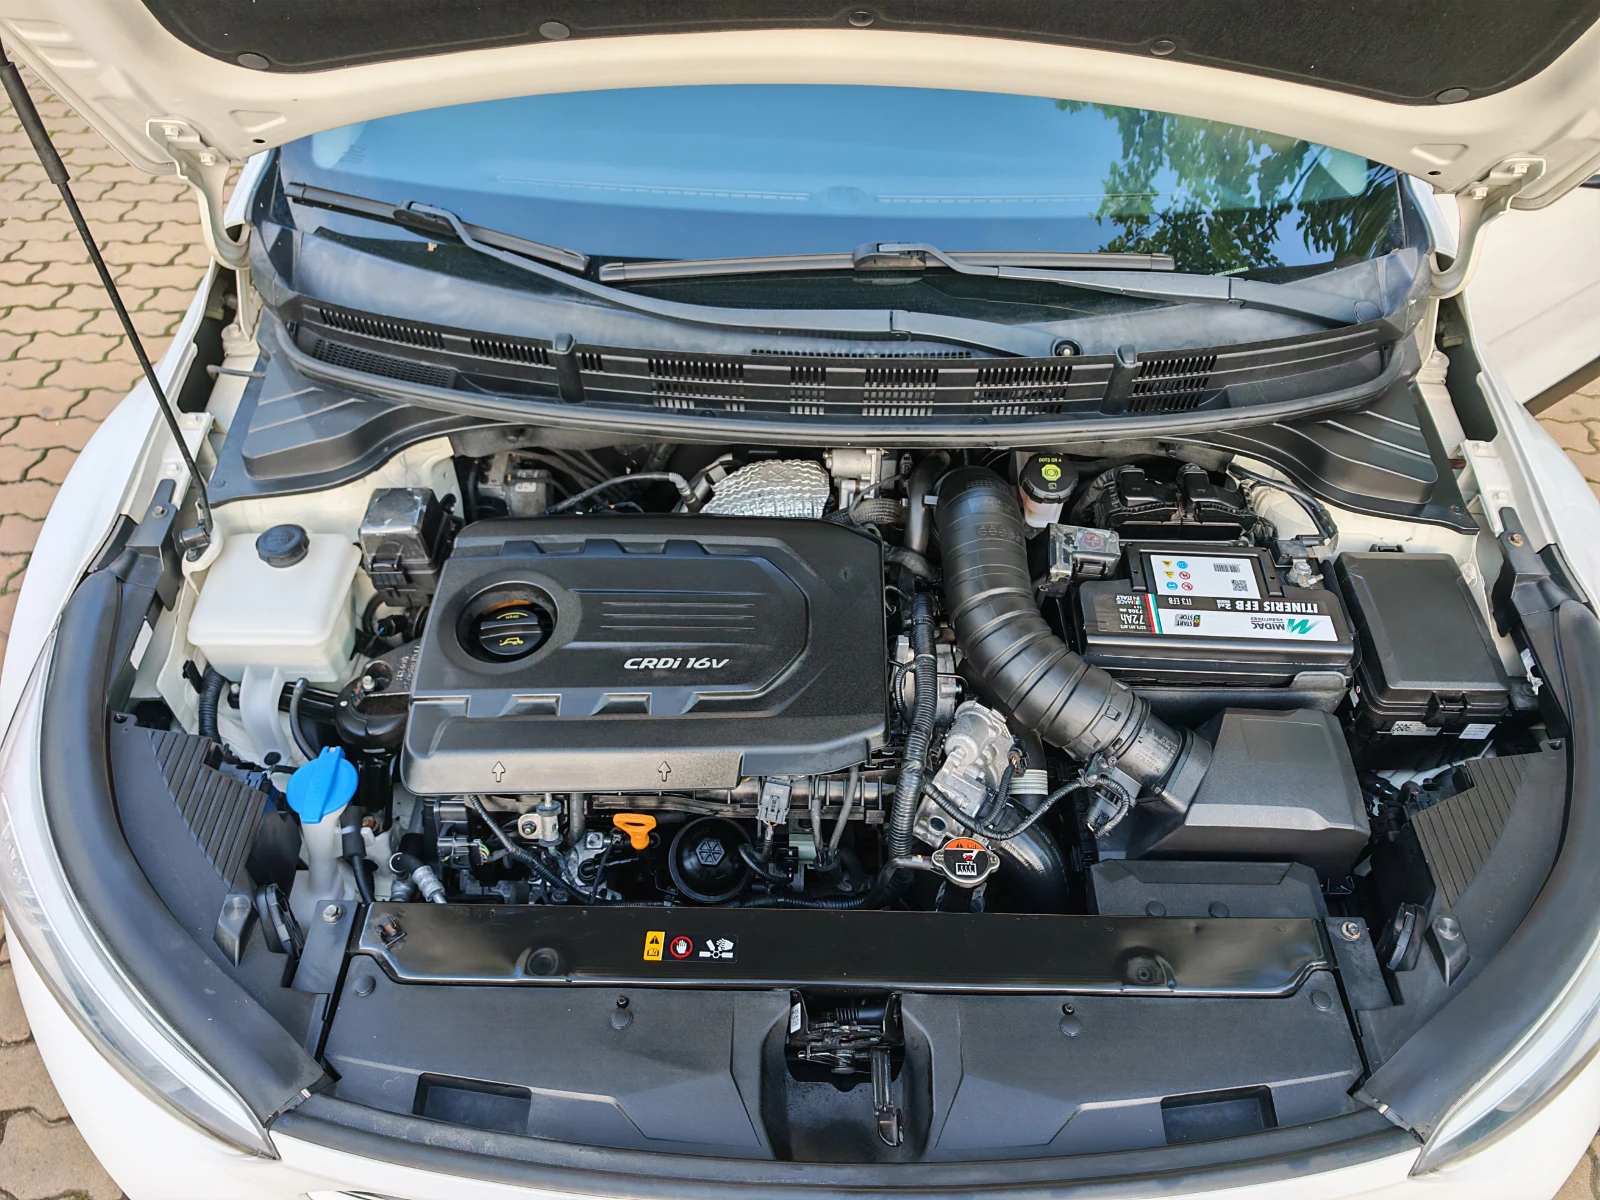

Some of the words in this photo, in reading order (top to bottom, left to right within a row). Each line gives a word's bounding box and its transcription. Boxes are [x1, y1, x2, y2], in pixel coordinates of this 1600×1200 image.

[1168, 597, 1180, 605] EFB
[1235, 600, 1260, 611] EFB
[1263, 601, 1318, 613] ITINERIS
[1120, 614, 1145, 624] 72Ah
[1252, 622, 1285, 631] MIDAC
[623, 657, 683, 669] CRDi
